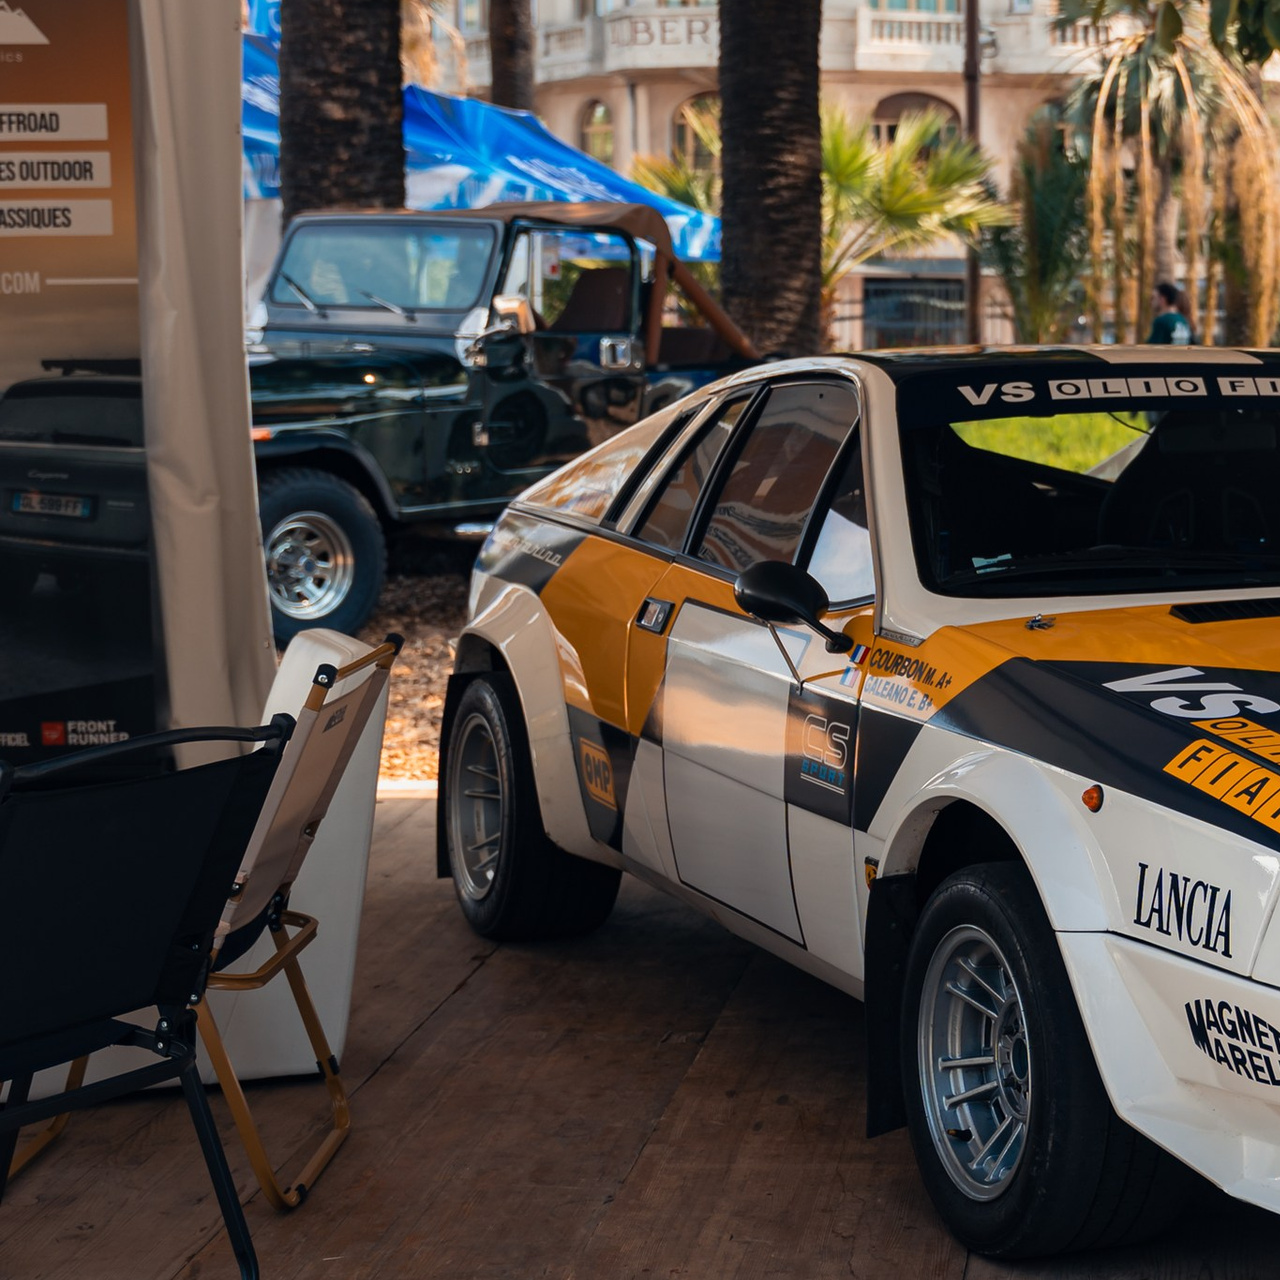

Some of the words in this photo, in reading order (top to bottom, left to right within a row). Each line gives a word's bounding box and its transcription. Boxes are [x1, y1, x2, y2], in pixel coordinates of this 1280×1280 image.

[20, 160, 94, 181] OUTDOOR
[957, 380, 1036, 406] VS
[1053, 377, 1203, 398] OLIO
[869, 648, 929, 682] COURBON
[935, 672, 952, 689] A+
[864, 676, 909, 704] GALEANO
[67, 720, 117, 732] FRONT
[802, 714, 850, 769] CS
[584, 751, 611, 794] OMP
[801, 759, 845, 786] SPORT
[1133, 862, 1233, 959] LANCIA
